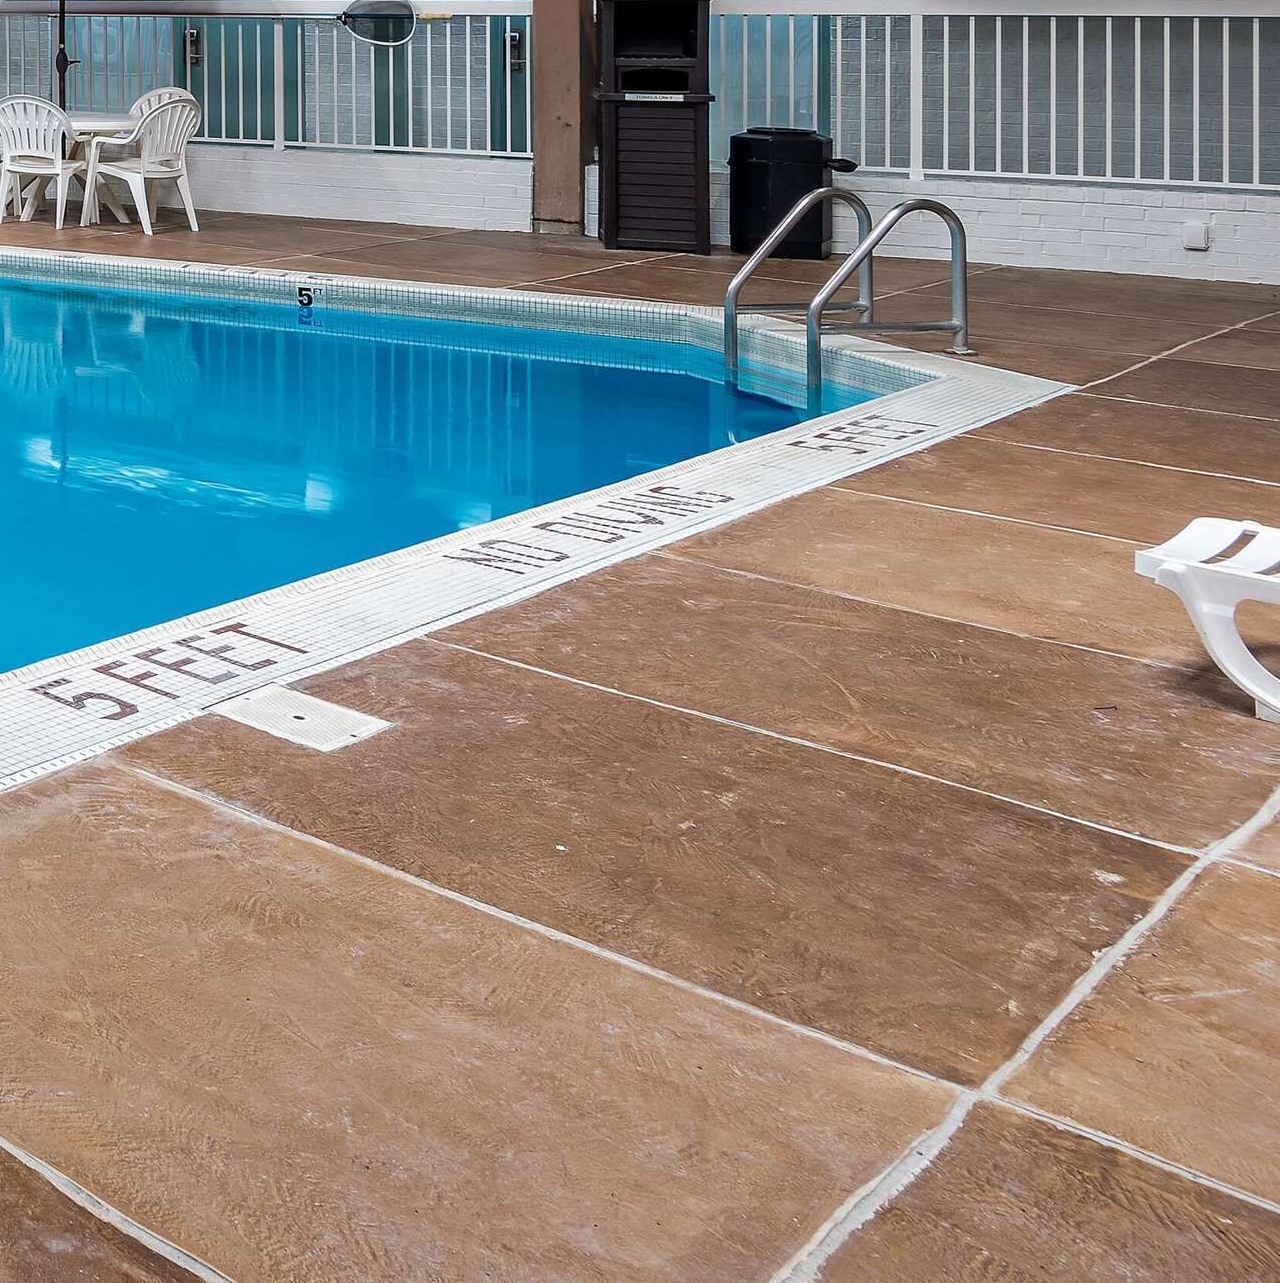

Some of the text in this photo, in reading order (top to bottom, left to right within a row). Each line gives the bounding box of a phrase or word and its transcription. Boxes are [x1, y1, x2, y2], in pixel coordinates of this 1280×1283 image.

[297, 286, 323, 307] 5 FT
[812, 414, 940, 447] FEET
[442, 485, 735, 575] NO DIVING
[28, 621, 310, 721] 5 FEET
